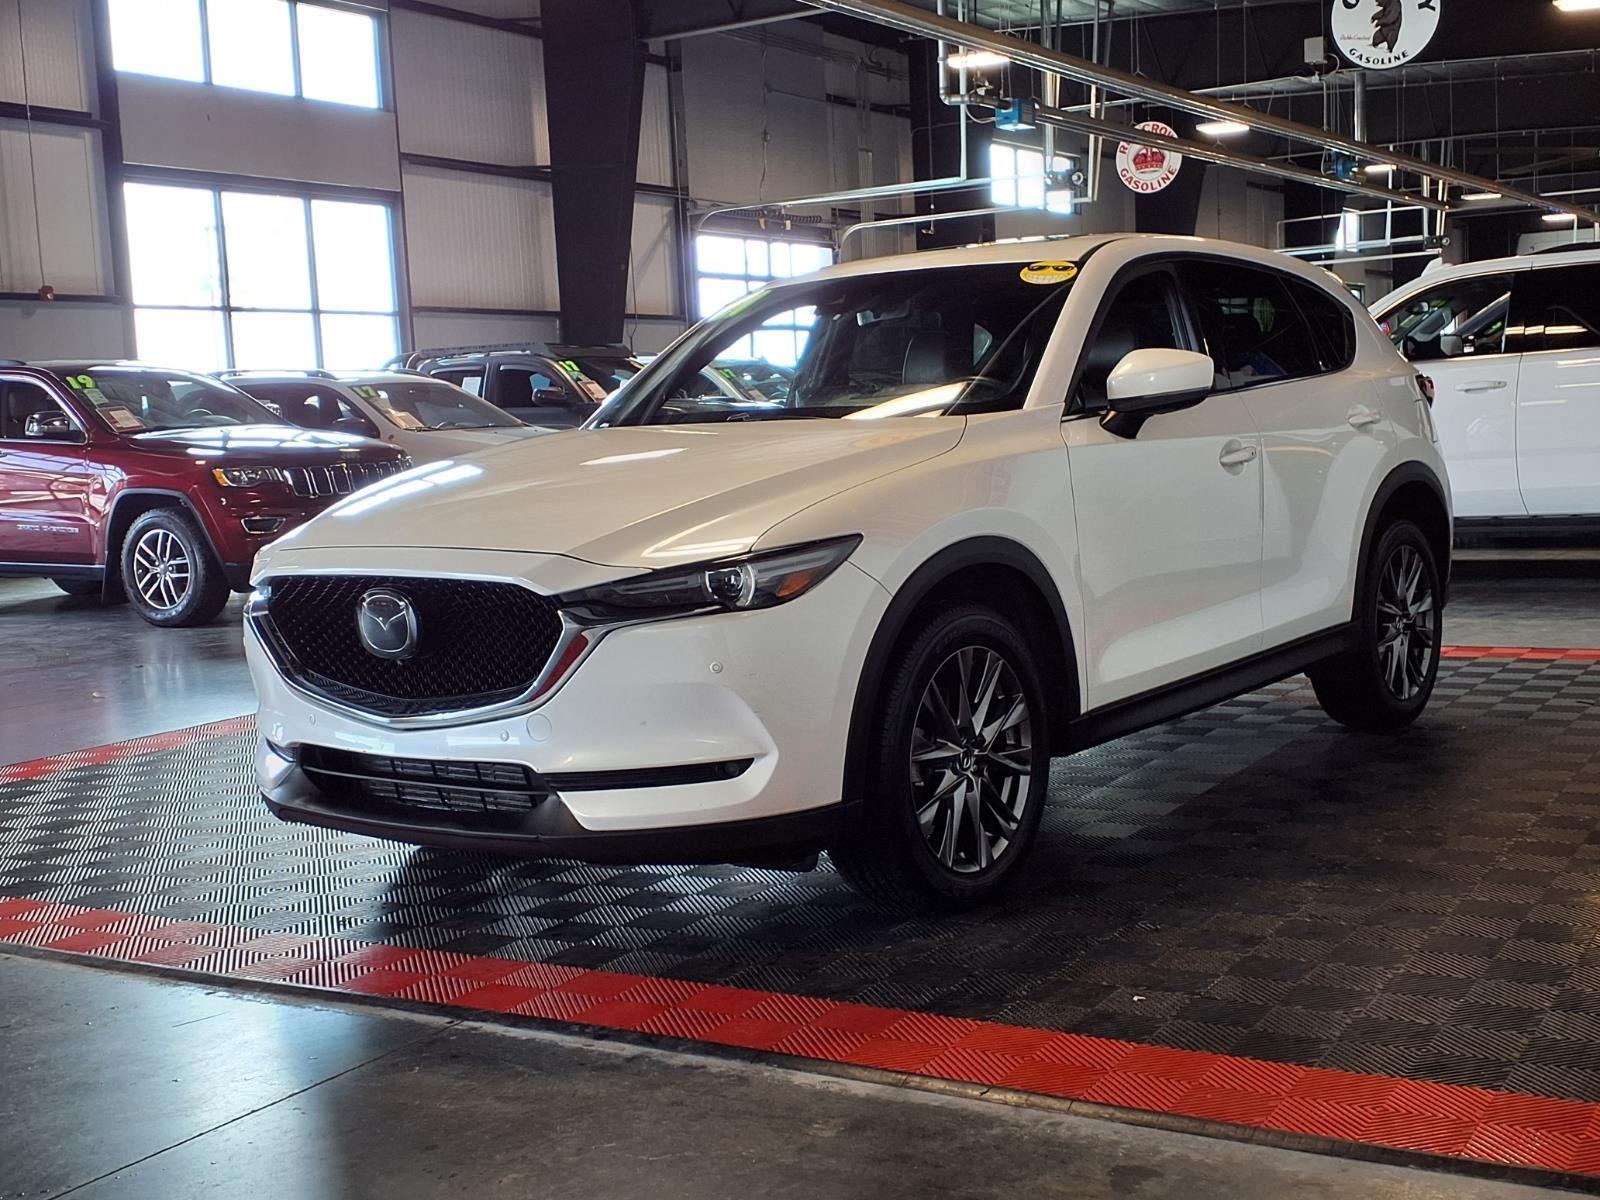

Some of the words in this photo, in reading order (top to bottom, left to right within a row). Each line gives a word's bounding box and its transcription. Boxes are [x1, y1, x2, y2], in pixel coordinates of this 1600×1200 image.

[1349, 48, 1409, 65] GASOLINE
[1120, 166, 1177, 191] GASOLINE
[558, 360, 580, 372] 17
[65, 374, 96, 389] 19
[352, 385, 379, 398] 17
